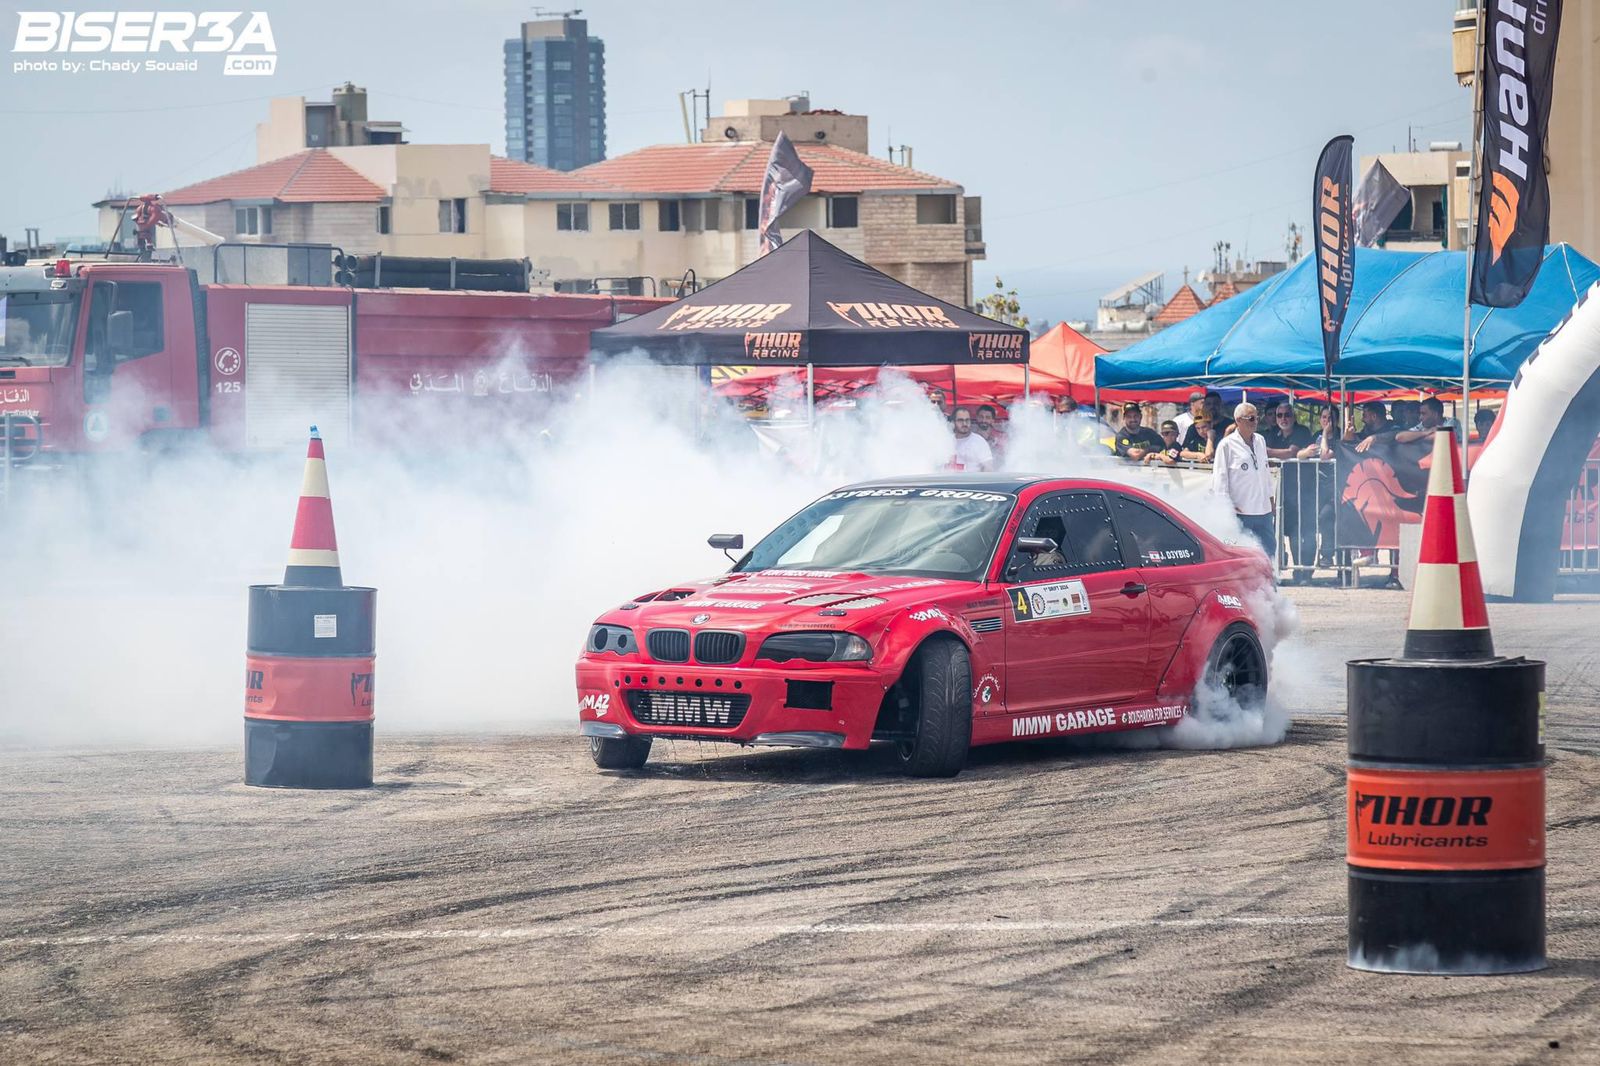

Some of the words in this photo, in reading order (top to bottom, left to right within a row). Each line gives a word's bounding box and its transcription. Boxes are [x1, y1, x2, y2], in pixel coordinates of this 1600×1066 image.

[1321, 175, 1341, 305] THOR
[678, 303, 792, 321] THOR
[836, 301, 946, 322] THOR
[746, 332, 802, 348] THOR
[972, 333, 1024, 349] THOR
[752, 348, 800, 359] RACING
[977, 350, 1022, 360] RACING
[215, 382, 241, 394] 125
[919, 489, 1008, 502] GROUP
[1017, 591, 1028, 615] 4
[651, 695, 732, 724] MMW
[1012, 715, 1052, 737] MMW
[1056, 708, 1117, 732] GARAGE
[1360, 794, 1493, 827] THOR
[1367, 831, 1489, 848] Lubricants
